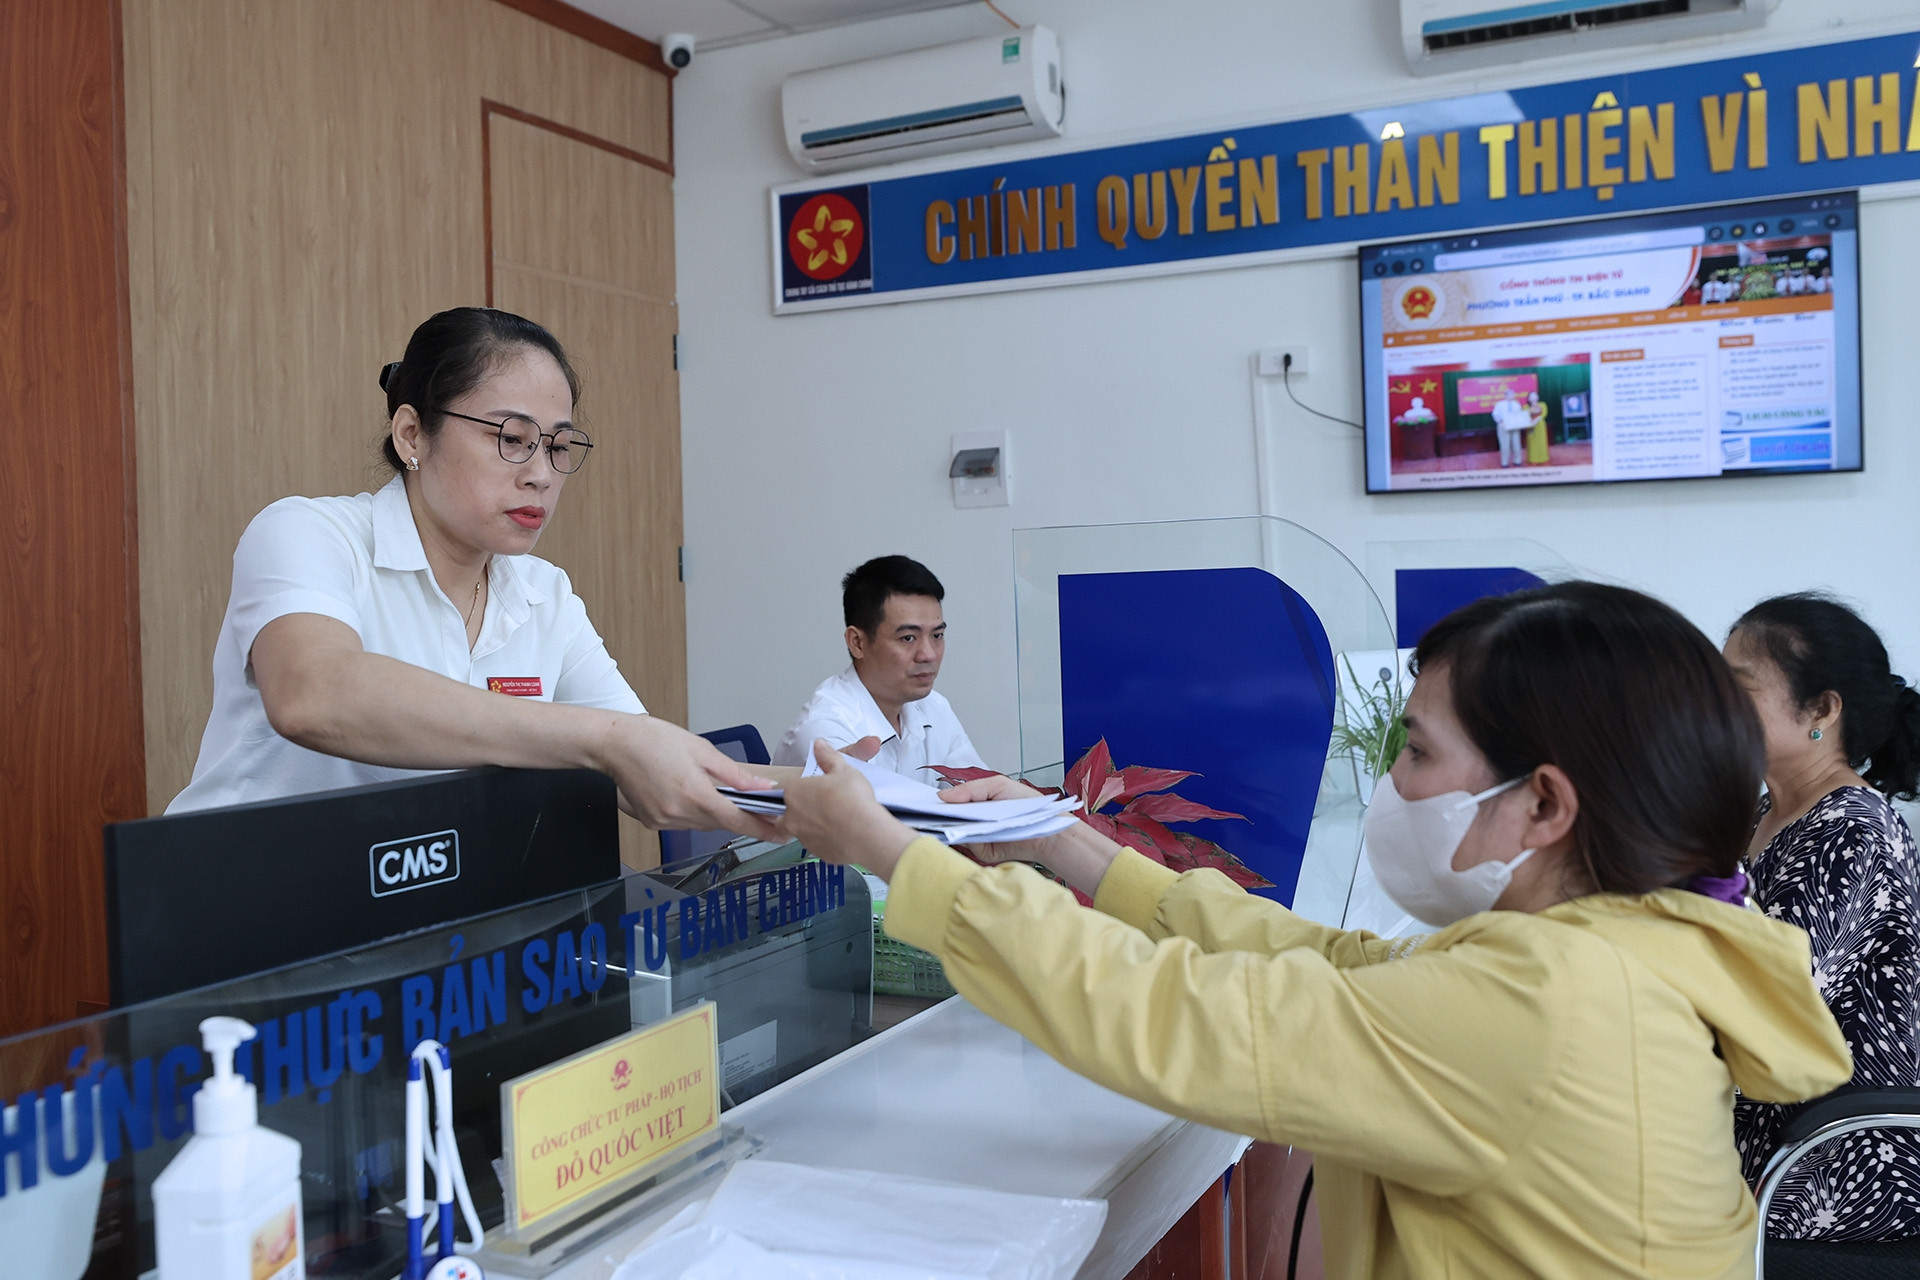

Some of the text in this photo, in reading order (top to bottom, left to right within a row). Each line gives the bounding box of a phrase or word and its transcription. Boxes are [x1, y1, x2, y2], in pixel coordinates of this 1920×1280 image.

[925, 176, 1077, 264] CHÍNH
[1096, 138, 1280, 249] QUYỀN
[1297, 121, 1461, 220] THÂN
[1479, 92, 1675, 201] THIỆN
[1701, 72, 1768, 173] VÌ
[378, 841, 448, 885] CMS
[235, 989, 384, 1106] THỰC
[401, 934, 507, 1057] BẢN
[521, 922, 607, 1014] SAO
[619, 888, 671, 979] TỪ
[679, 863, 748, 961] BẢN
[758, 848, 845, 932] CHÍNH
[531, 1131, 569, 1161] CÔNG
[570, 1113, 604, 1143] CHỨC
[625, 1089, 653, 1117] PHÁP
[660, 1080, 675, 1100] HỘ
[677, 1068, 703, 1093] TỊCH
[589, 1127, 642, 1175] QUỐC
[646, 1105, 685, 1142] VIỆT
